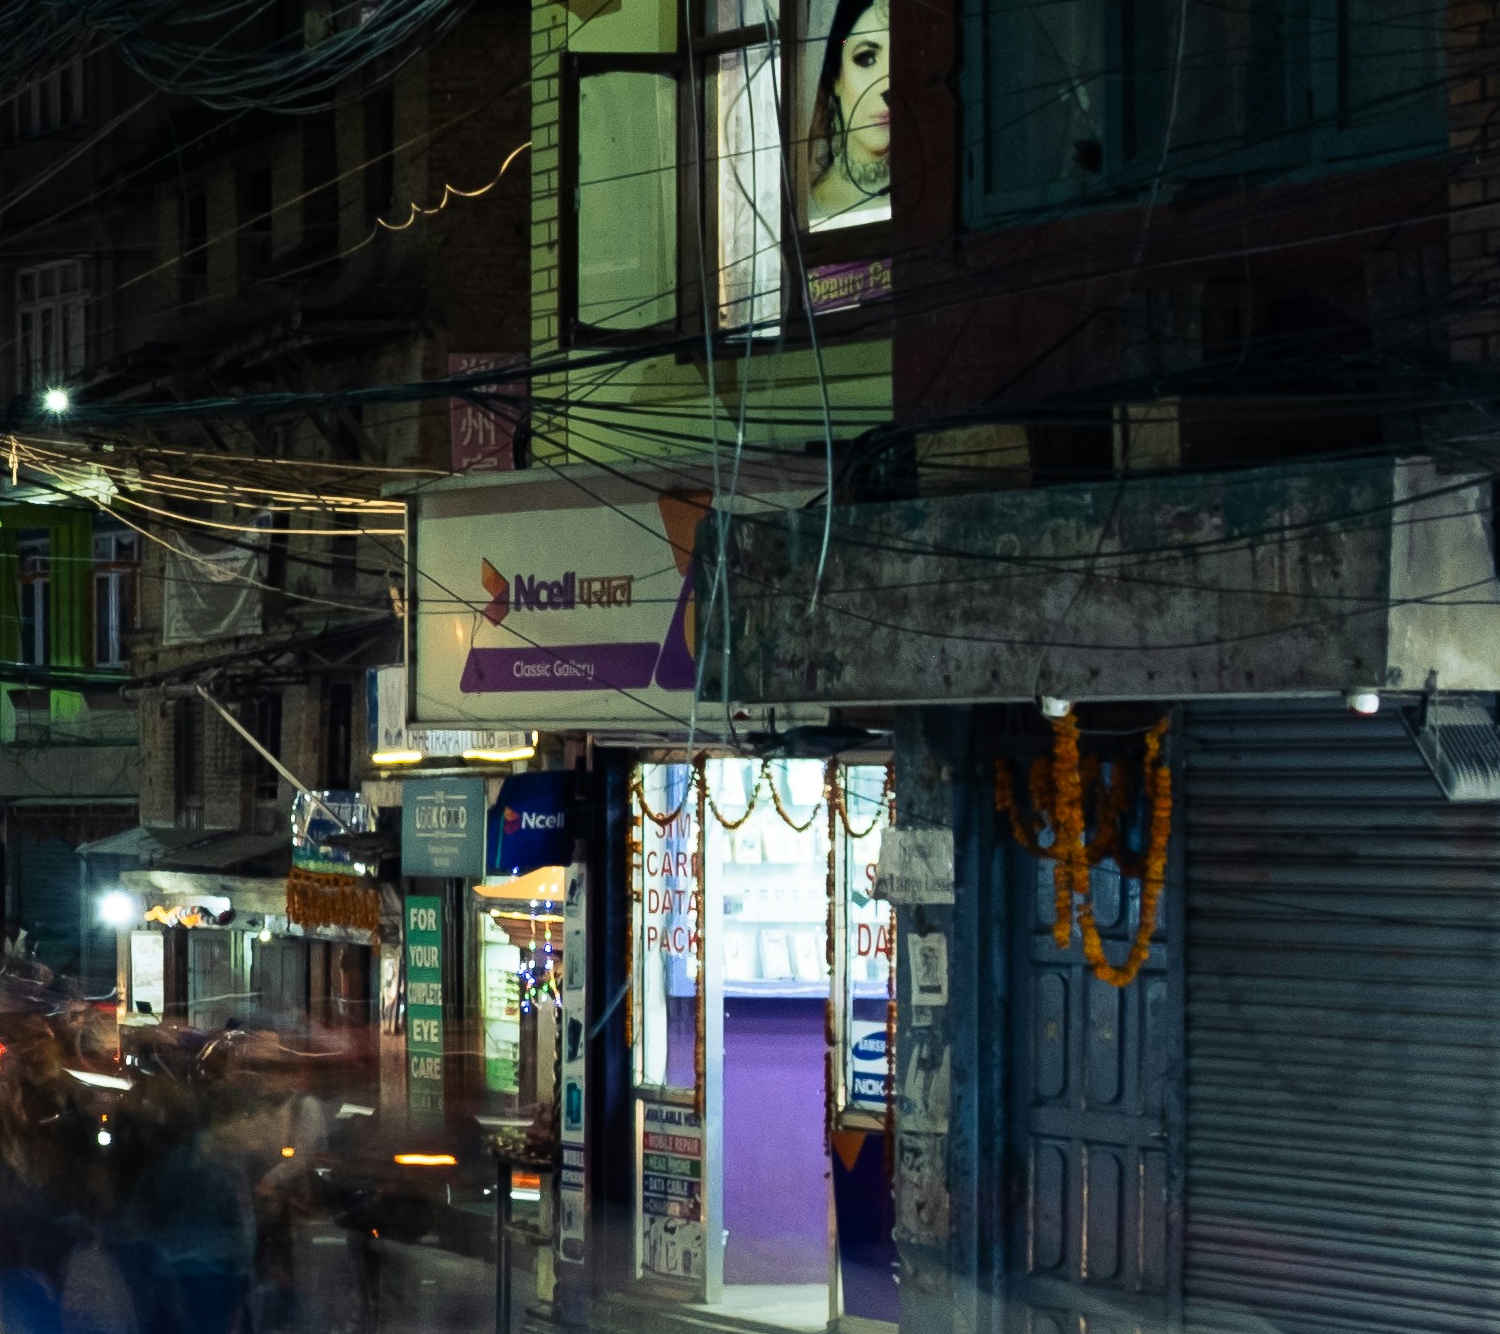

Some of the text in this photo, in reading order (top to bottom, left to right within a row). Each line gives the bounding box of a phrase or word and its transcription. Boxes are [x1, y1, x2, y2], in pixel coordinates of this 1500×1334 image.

[513, 570, 576, 611] Ncell
[577, 574, 634, 609] पसल
[512, 659, 595, 681] Classic Gallery
[521, 811, 565, 830] Ncell
[655, 811, 691, 840] SIM
[648, 888, 700, 915] DATA
[410, 907, 436, 932] FOR
[409, 944, 438, 969] YOUR
[412, 1017, 440, 1043] EYE
[411, 1055, 442, 1080] CARE
